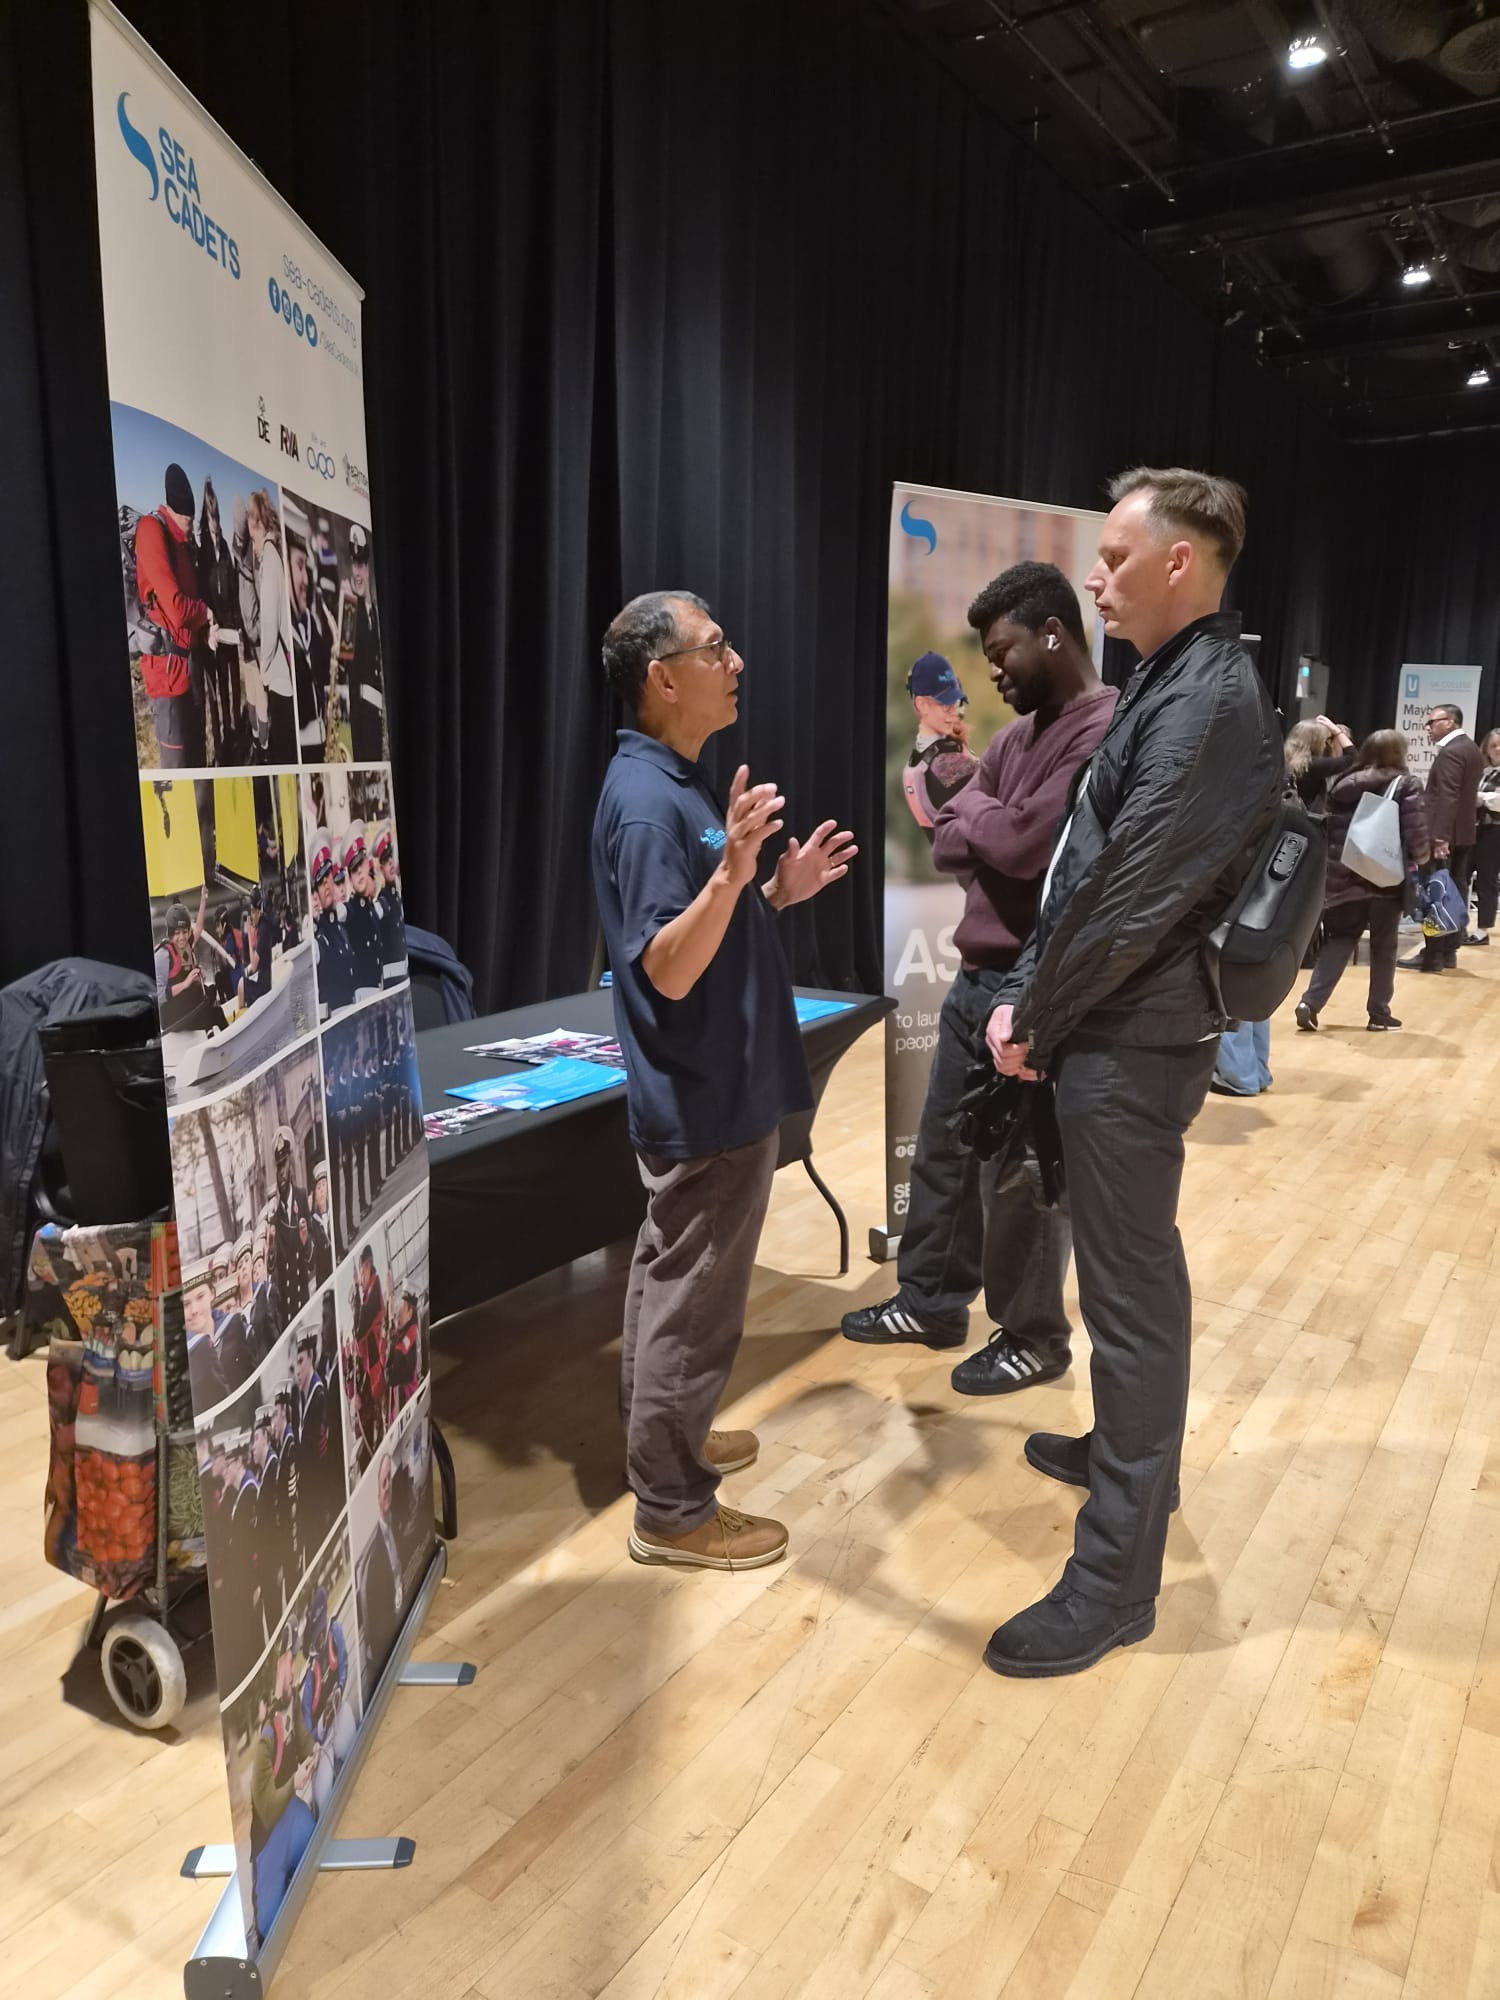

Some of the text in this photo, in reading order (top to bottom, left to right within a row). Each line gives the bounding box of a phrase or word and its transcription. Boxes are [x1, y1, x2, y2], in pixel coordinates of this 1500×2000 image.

[158, 127, 201, 204] SEA
[164, 177, 241, 281] CADETS
[1403, 703, 1432, 719] Mayb
[1406, 750, 1436, 762] ou Th
[893, 924, 962, 987] AS
[896, 1012, 913, 1029] to
[893, 1182, 911, 1199] SE
